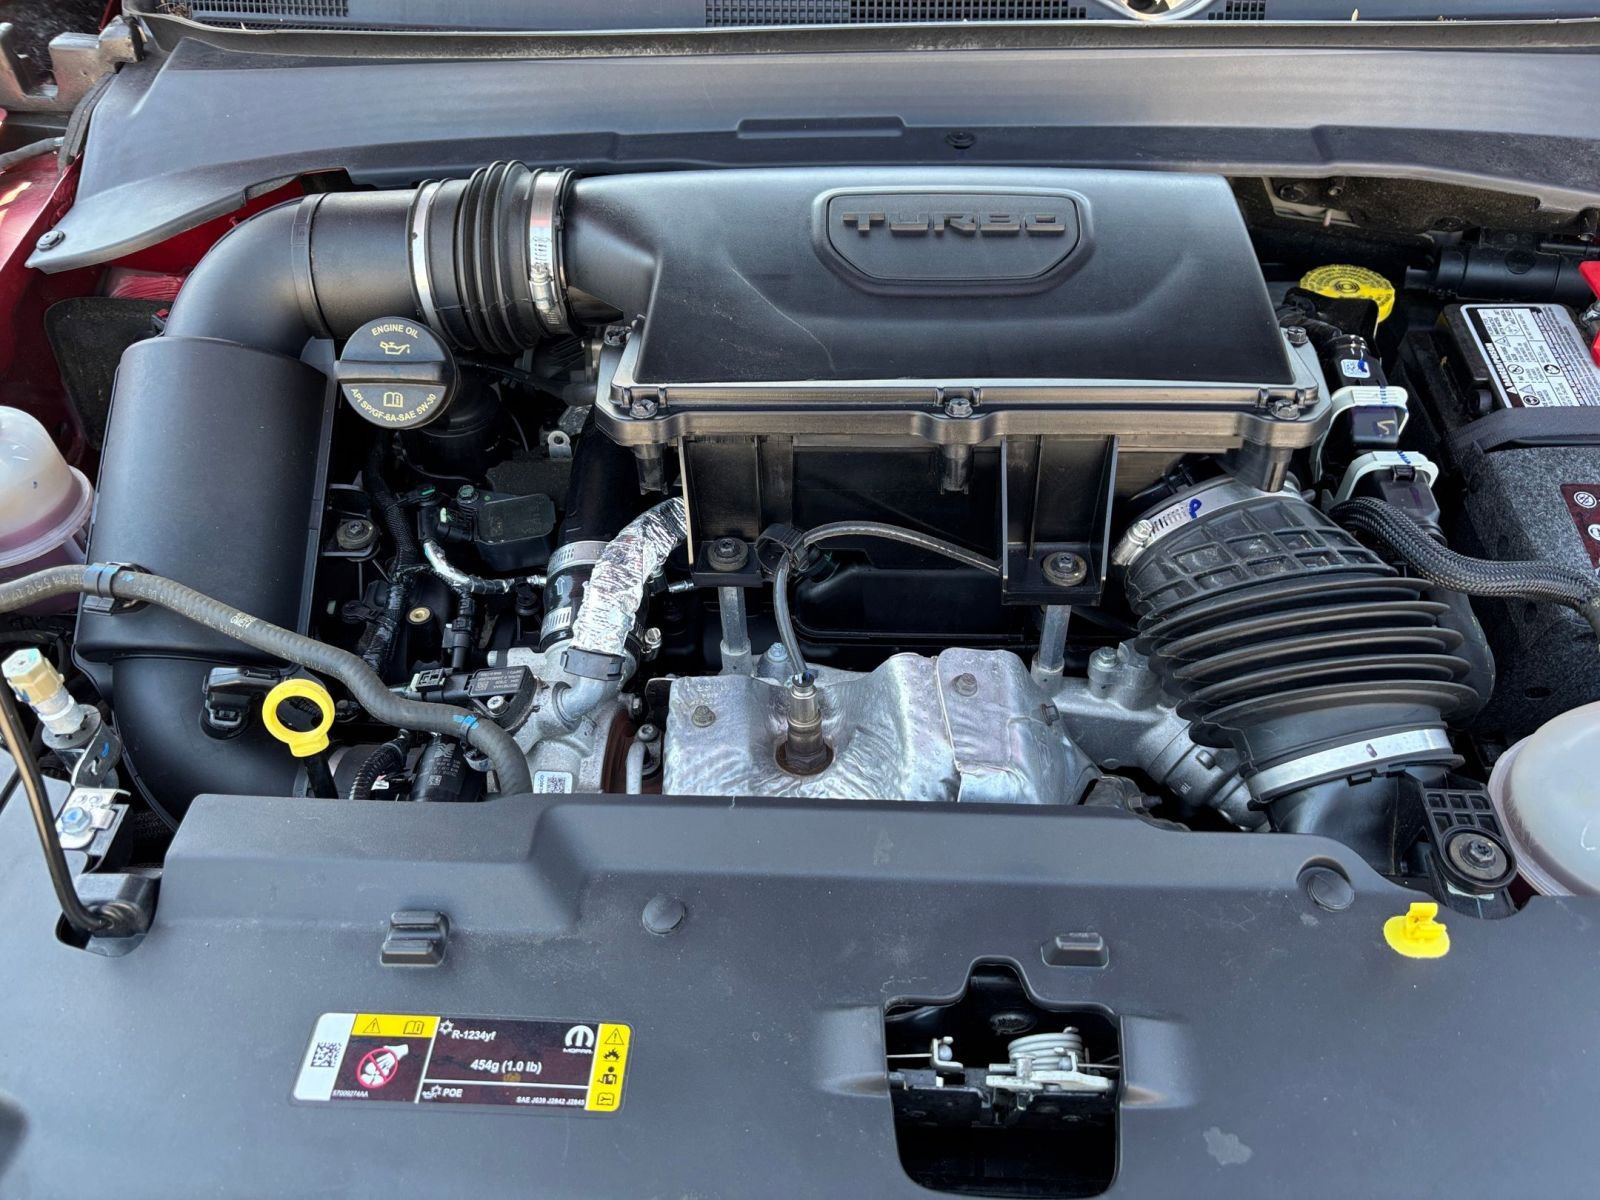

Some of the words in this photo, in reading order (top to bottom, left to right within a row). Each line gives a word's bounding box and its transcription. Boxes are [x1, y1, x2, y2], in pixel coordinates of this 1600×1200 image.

[842, 211, 1066, 233] TURBO
[371, 323, 404, 336] ENGINE
[405, 326, 419, 339] OIL
[351, 388, 361, 403] API
[416, 393, 437, 415] 5W-30
[451, 1029, 497, 1042] R-1234yf
[470, 1059, 500, 1074] 454g
[501, 1060, 524, 1074] (1.0
[525, 1061, 543, 1075] lb)
[442, 1087, 463, 1098] POE
[516, 1095, 531, 1104] SAE
